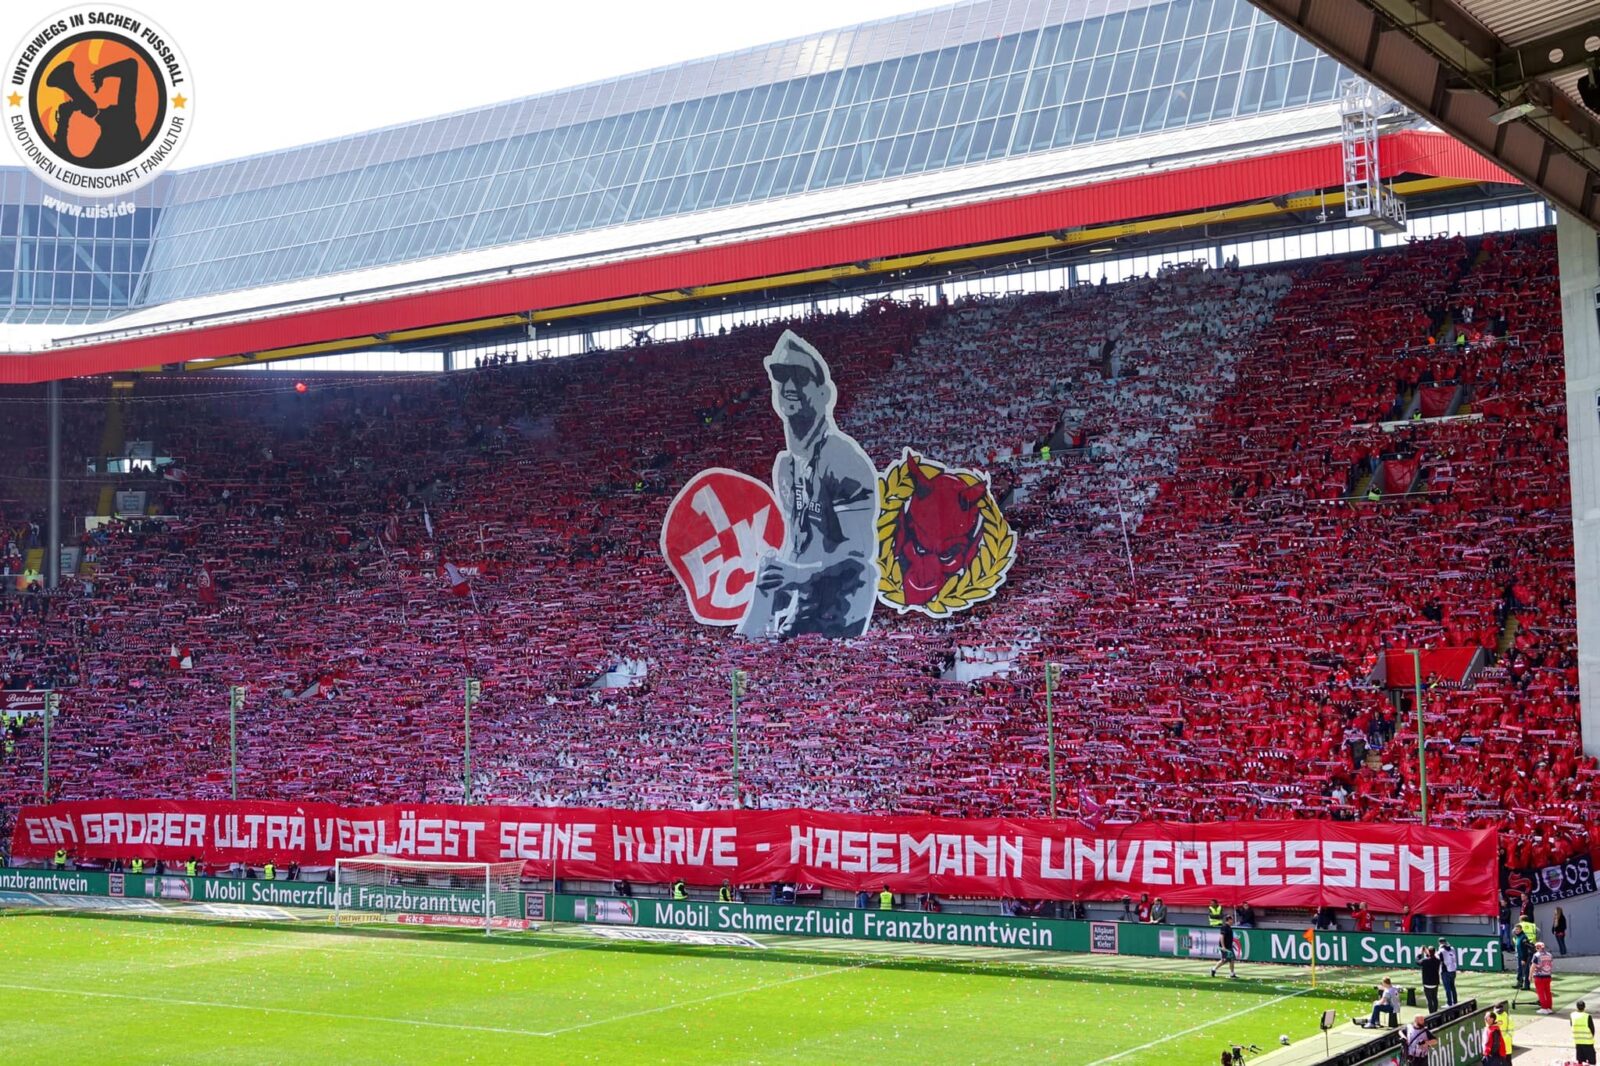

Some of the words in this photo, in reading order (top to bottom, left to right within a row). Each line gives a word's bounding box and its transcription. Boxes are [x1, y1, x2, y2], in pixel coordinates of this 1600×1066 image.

[25, 814, 78, 844] EIN
[314, 811, 485, 857] VERLÄSST
[500, 822, 597, 861] SEINE
[790, 825, 1024, 878] HASEMANN
[1040, 837, 1450, 892] UNVERGESSEN!
[205, 880, 246, 900] Mobil
[252, 882, 352, 907] Schmerzfluid
[359, 886, 497, 915] Franzbranntwein
[655, 902, 709, 927] Mobil
[718, 906, 854, 935] Schmerzfluid
[863, 913, 1053, 946] Franzbranntwein
[1271, 933, 1348, 962] Mobil
[1428, 1027, 1455, 1066] obil
